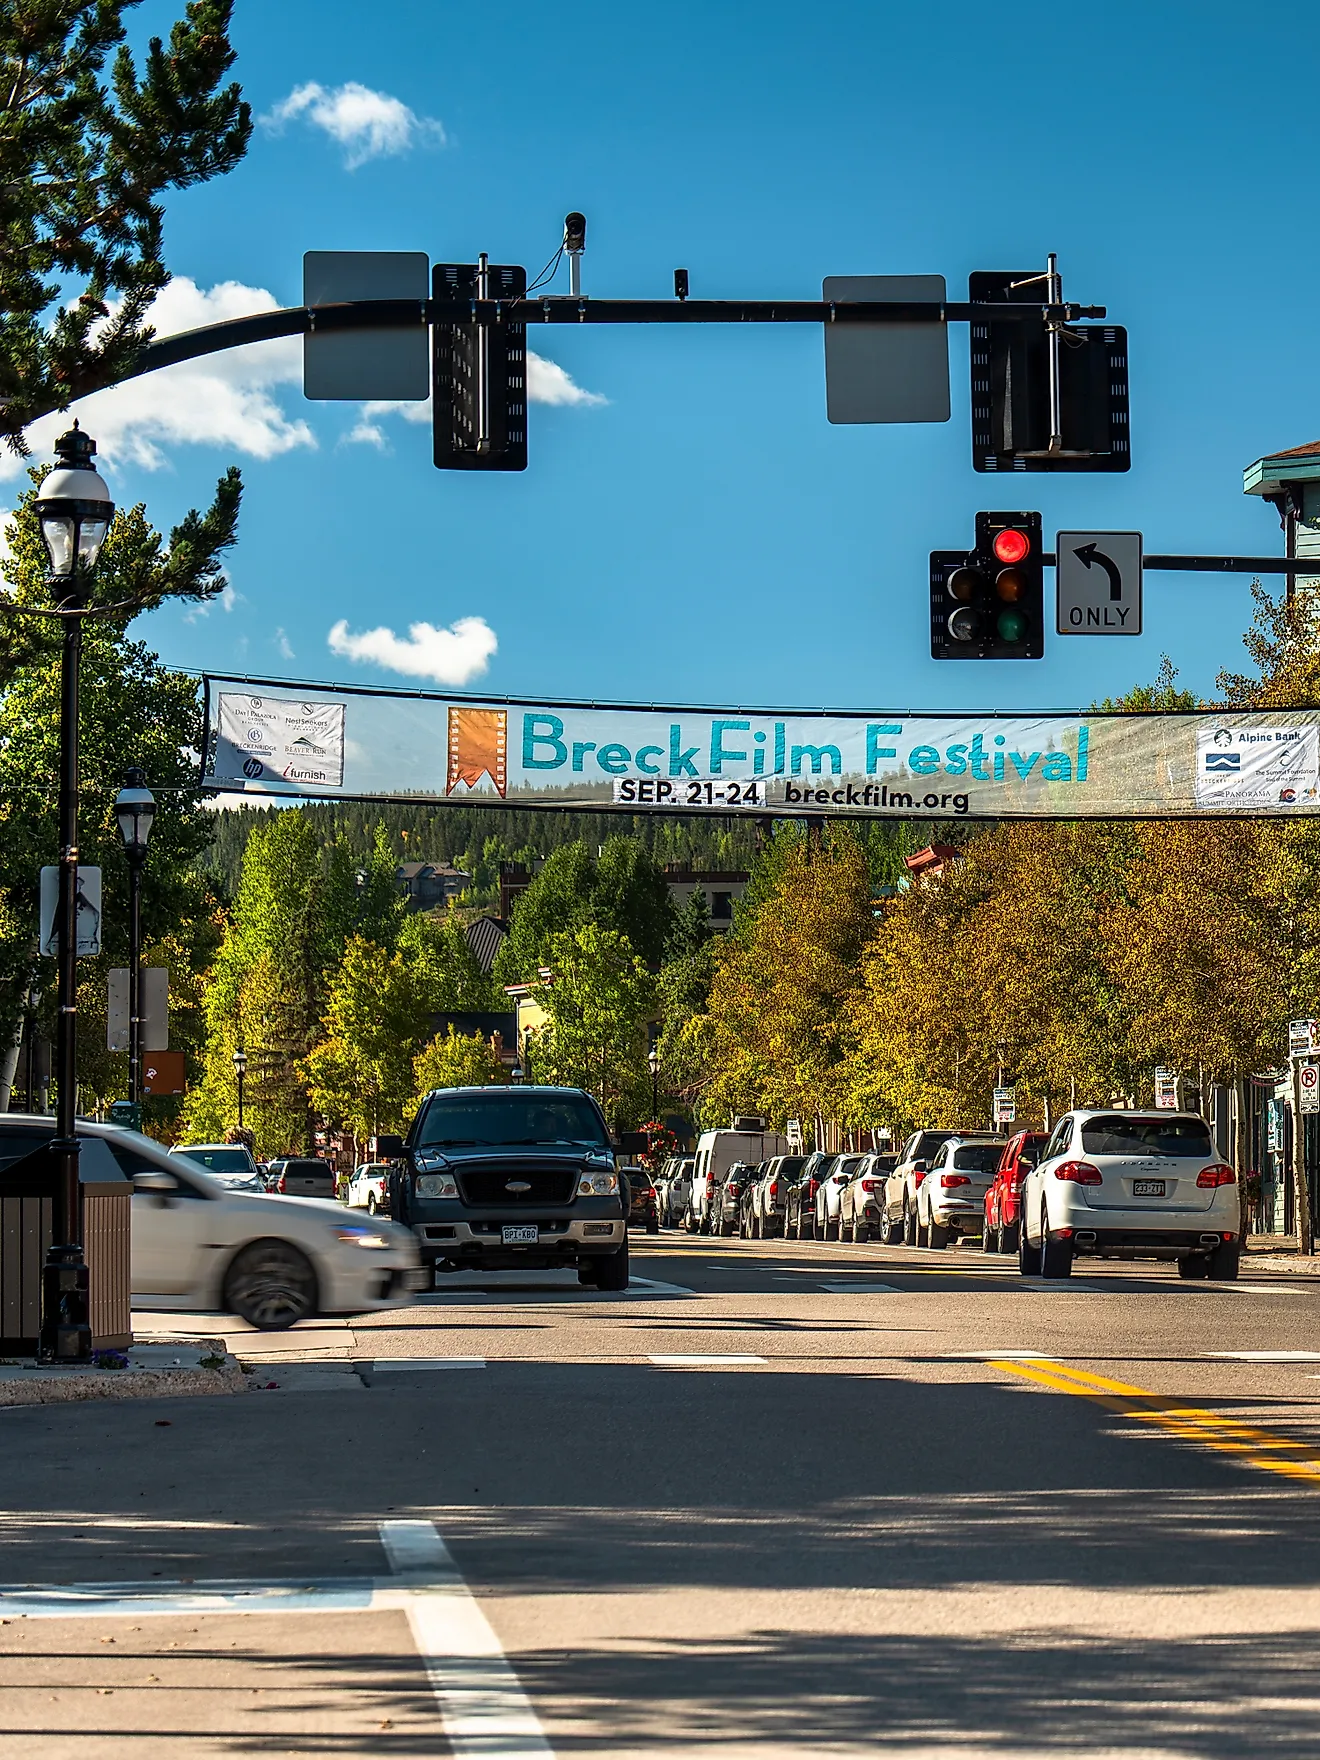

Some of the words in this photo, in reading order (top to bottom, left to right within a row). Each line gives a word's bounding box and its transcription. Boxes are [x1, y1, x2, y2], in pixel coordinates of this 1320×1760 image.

[1069, 606, 1131, 626] ONLY
[231, 742, 277, 752] BRECKENRIDGE
[1238, 732, 1273, 744] Alpine
[1275, 731, 1301, 741] Bank
[284, 745, 310, 754] BEAVER
[312, 747, 327, 755] RUN
[708, 719, 842, 775] Film
[865, 723, 1090, 782] Festival
[245, 759, 261, 778] hp
[620, 779, 677, 803] SEP.
[686, 781, 760, 805] 21-24
[784, 780, 970, 815] breckfilm.org
[1225, 790, 1271, 798] PANORAMA
